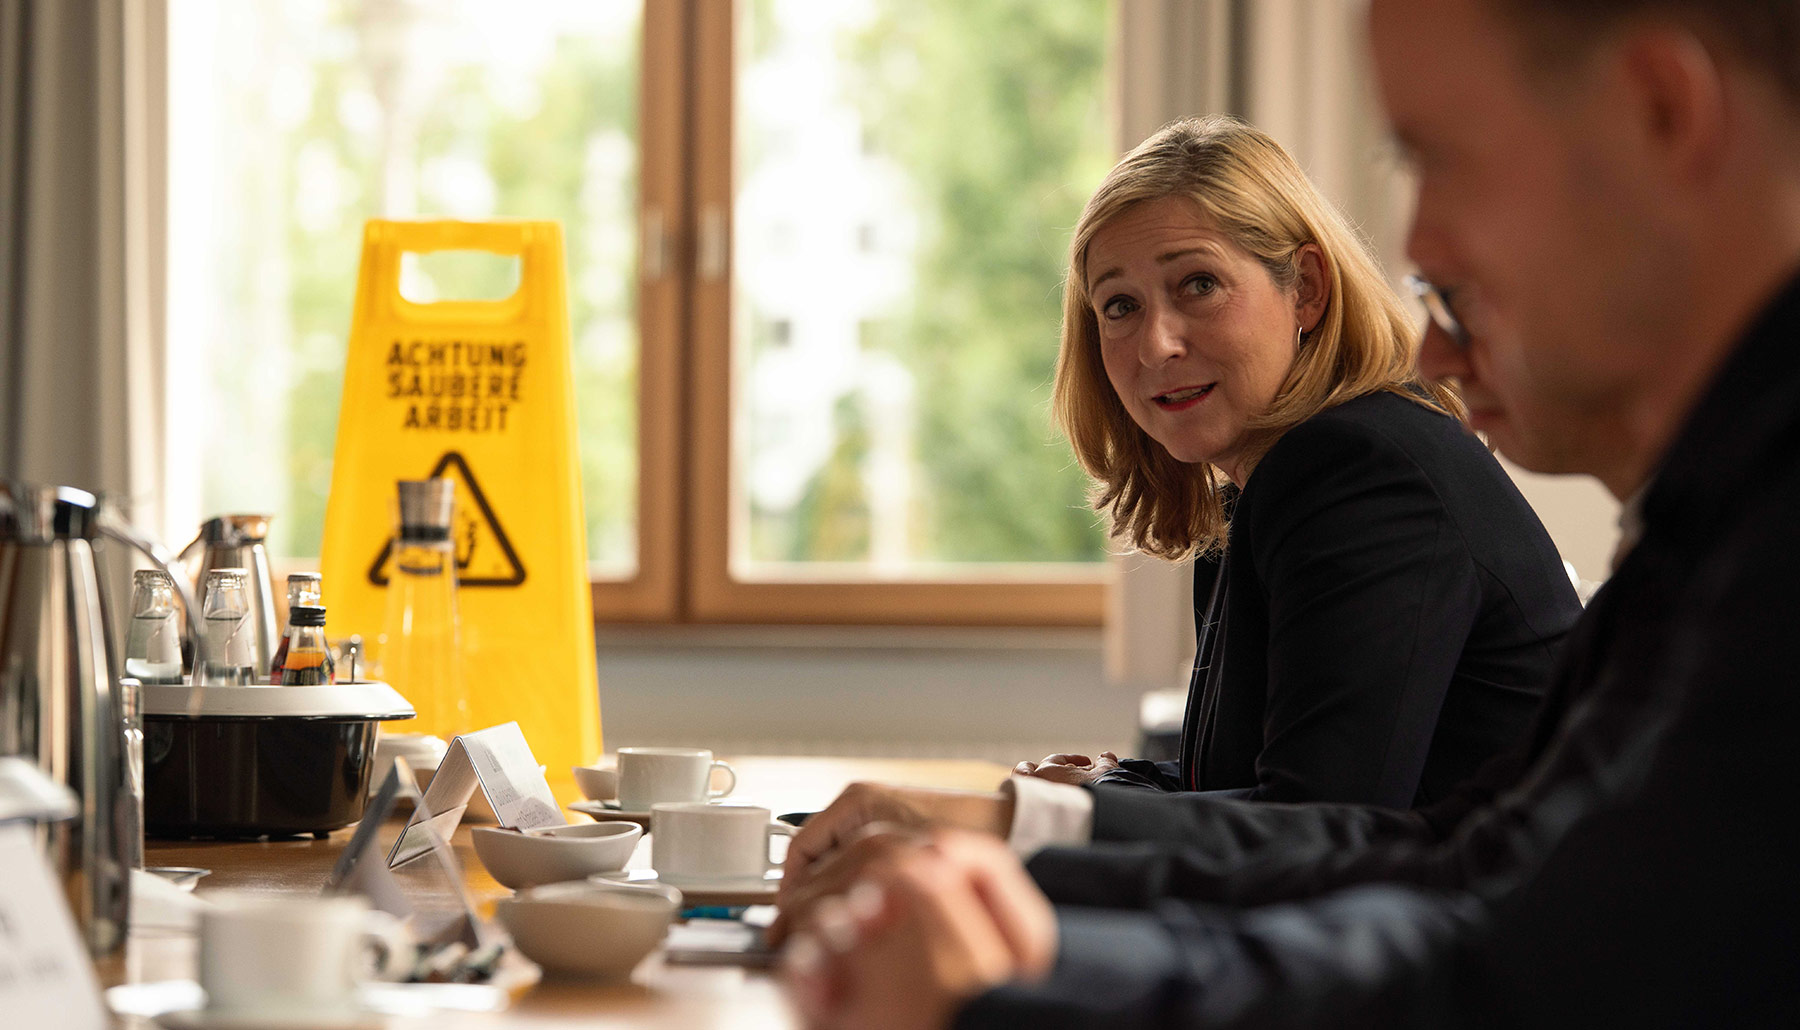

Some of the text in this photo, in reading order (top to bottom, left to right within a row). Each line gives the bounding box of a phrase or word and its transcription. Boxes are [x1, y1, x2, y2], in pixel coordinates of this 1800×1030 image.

[387, 341, 527, 367] ACHTUNG
[387, 371, 521, 400] SAUBERE
[403, 404, 508, 431] ARBEIT
